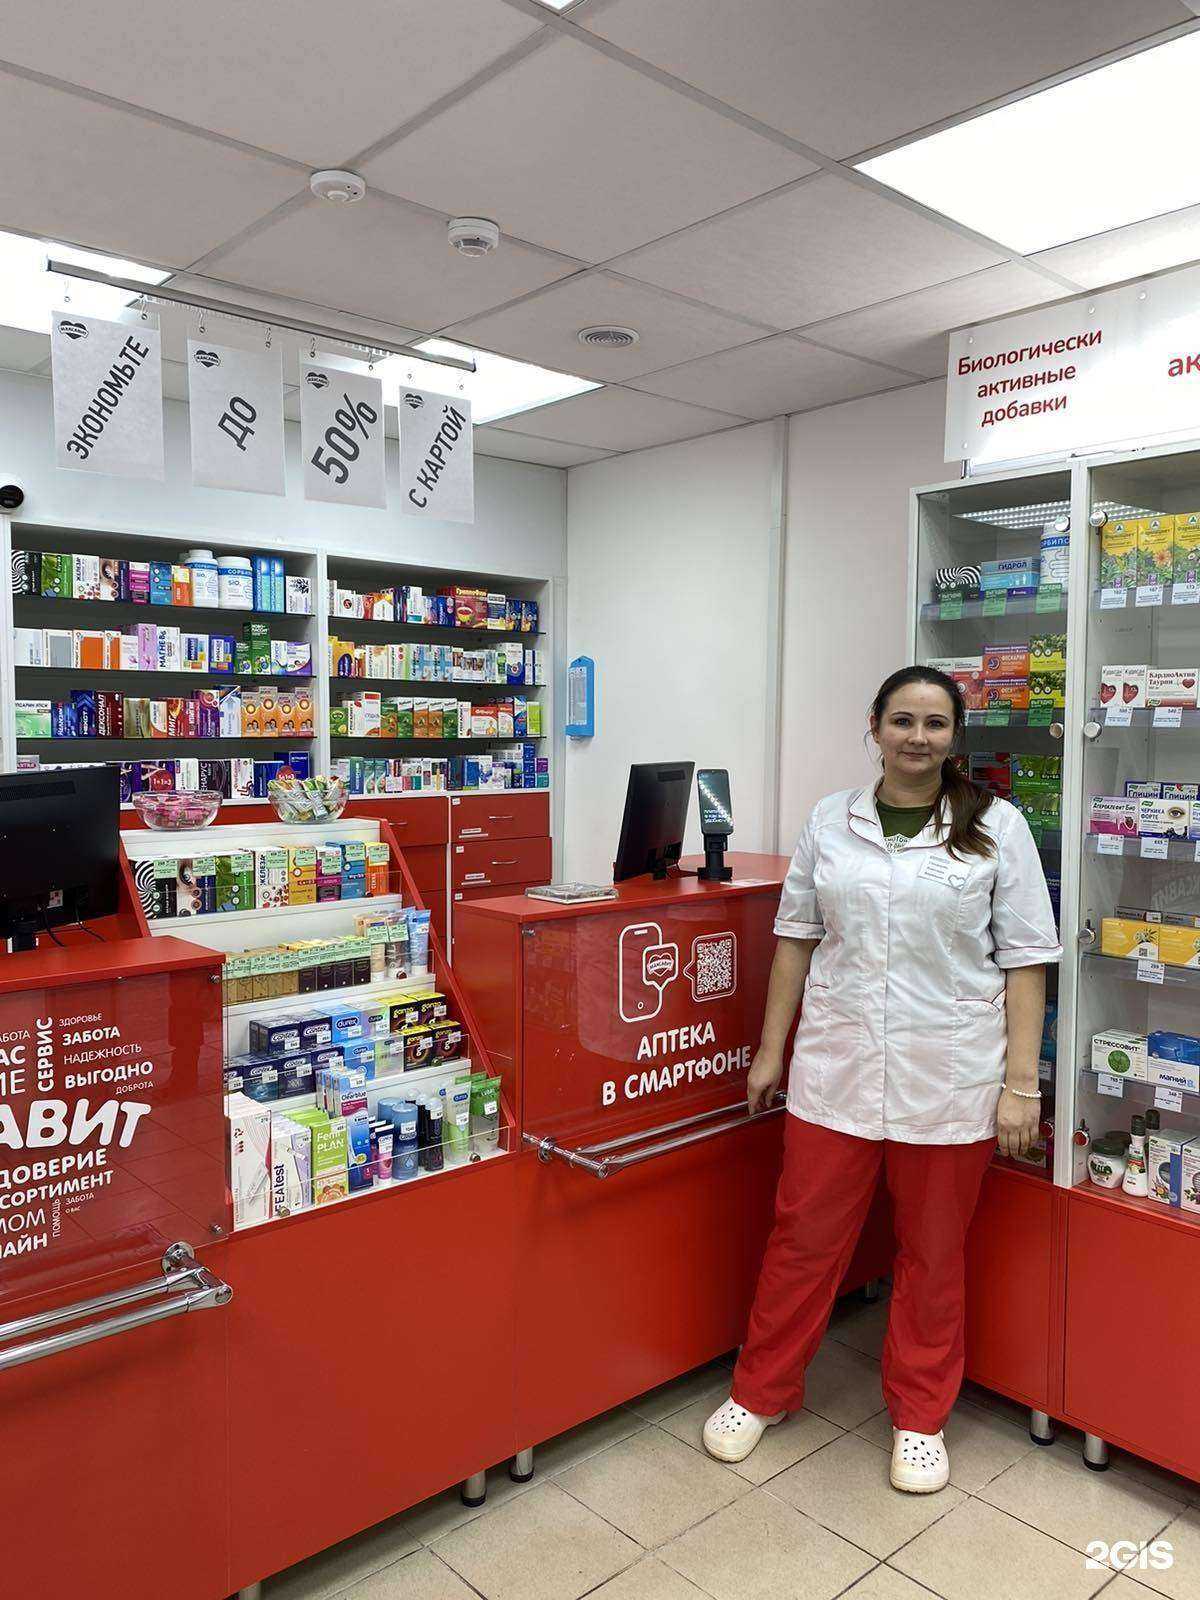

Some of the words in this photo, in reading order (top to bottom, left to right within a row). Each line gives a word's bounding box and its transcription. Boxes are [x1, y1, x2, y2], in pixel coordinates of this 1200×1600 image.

[958, 329, 1102, 376] Биологически
[977, 365, 1076, 398] активные
[66, 335, 150, 461] ЭКОНОМЬТЕ
[982, 395, 1067, 427] добавки
[217, 395, 257, 452] ДО
[311, 393, 378, 485] 50%
[408, 487, 427, 509] С
[418, 405, 467, 491] КАРТОЙ
[259, 854, 267, 886] ЖЕЛЕЗА
[59, 1012, 103, 1027] ЗДОРОВЬЕ
[337, 1017, 359, 1028] durex
[62, 1026, 121, 1046] ЗАБОТА
[637, 1021, 716, 1061] АПТЕКА
[1093, 1038, 1140, 1053] СТРЕССОВИТ
[36, 1017, 54, 1092] СЕРВИС
[64, 1043, 142, 1065] НАДЕЖНОСТЬ
[65, 1061, 154, 1089] ВЫГОДНО
[115, 1081, 154, 1095] ДОБРОТА
[602, 1080, 617, 1107] В
[624, 1045, 751, 1100] СМАРТФОНЕ
[341, 1091, 366, 1101] Clearblue
[317, 1139, 344, 1153] PLAN
[65, 1192, 95, 1206] ЗАБОТА
[52, 1198, 61, 1238] ПОМОЩЬ
[0, 1233, 47, 1260] АЙН
